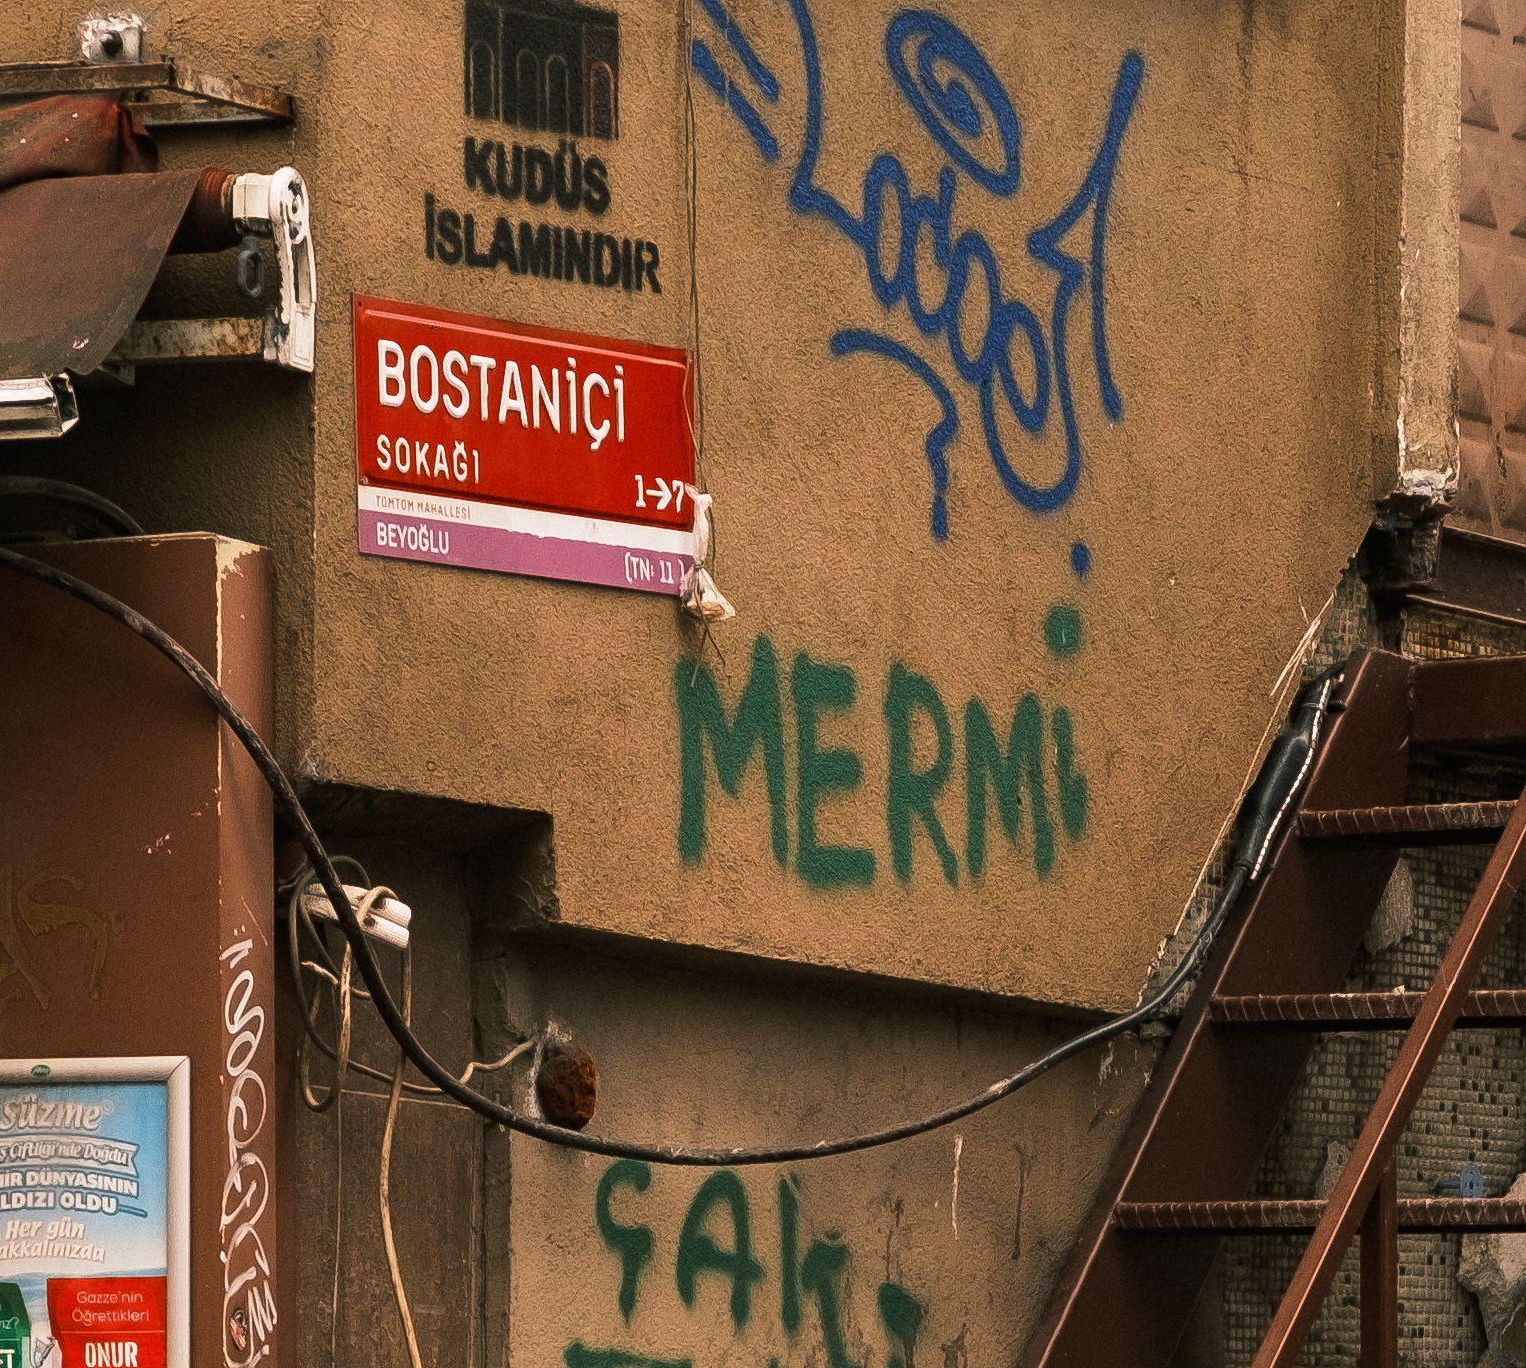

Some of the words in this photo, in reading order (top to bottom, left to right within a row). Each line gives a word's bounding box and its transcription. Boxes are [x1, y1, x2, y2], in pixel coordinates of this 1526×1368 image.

[463, 136, 611, 215] KUDÜS
[376, 339, 627, 452] BOSTANİÇİ
[376, 434, 481, 485] SOKAĞI
[375, 495, 414, 512] TOMTOM
[376, 521, 450, 555] BEYOĞLU
[84, 1143, 127, 1165] Doğdu
[25, 1167, 138, 1197] DÜNYASININ
[59, 1192, 117, 1214] OLDU
[5, 1219, 40, 1241] Her
[46, 1217, 85, 1241] gün
[85, 1341, 138, 1368] ONUR
